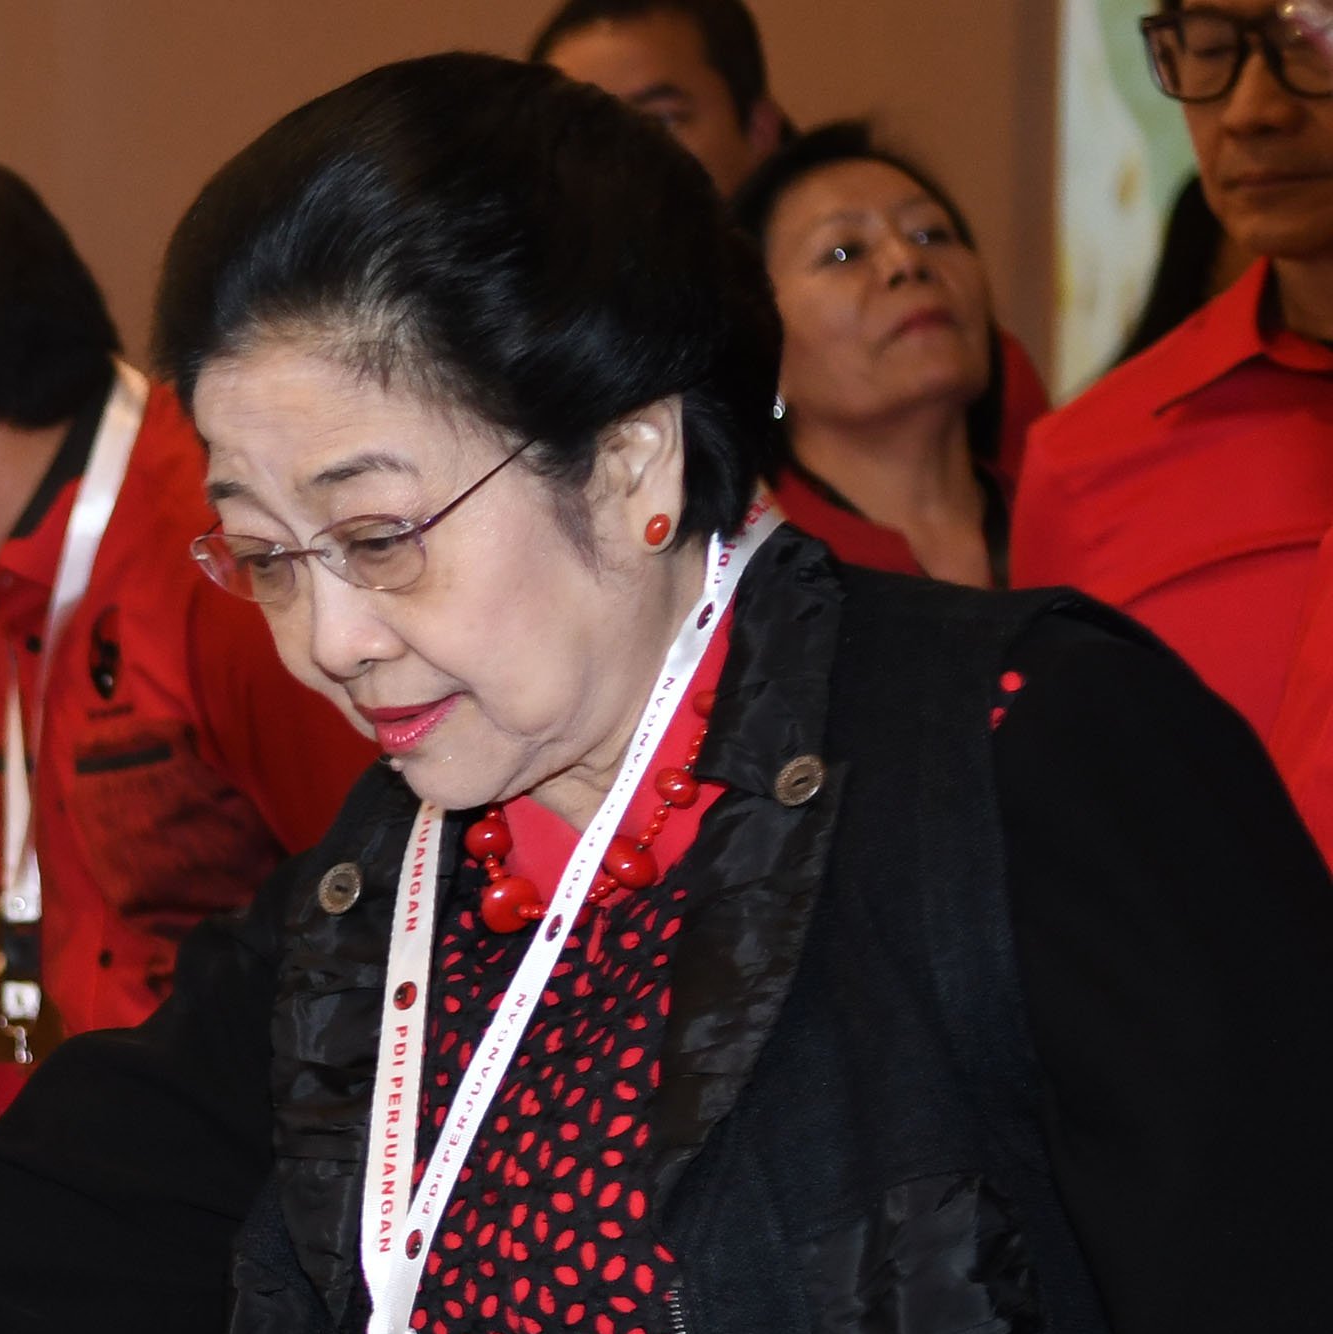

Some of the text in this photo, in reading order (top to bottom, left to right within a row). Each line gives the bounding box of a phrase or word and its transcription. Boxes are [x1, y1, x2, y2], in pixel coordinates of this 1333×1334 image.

[378, 1024, 409, 1253] PDI PERJUANGAN
[422, 993, 528, 1215] PDI PERJUANGAN
